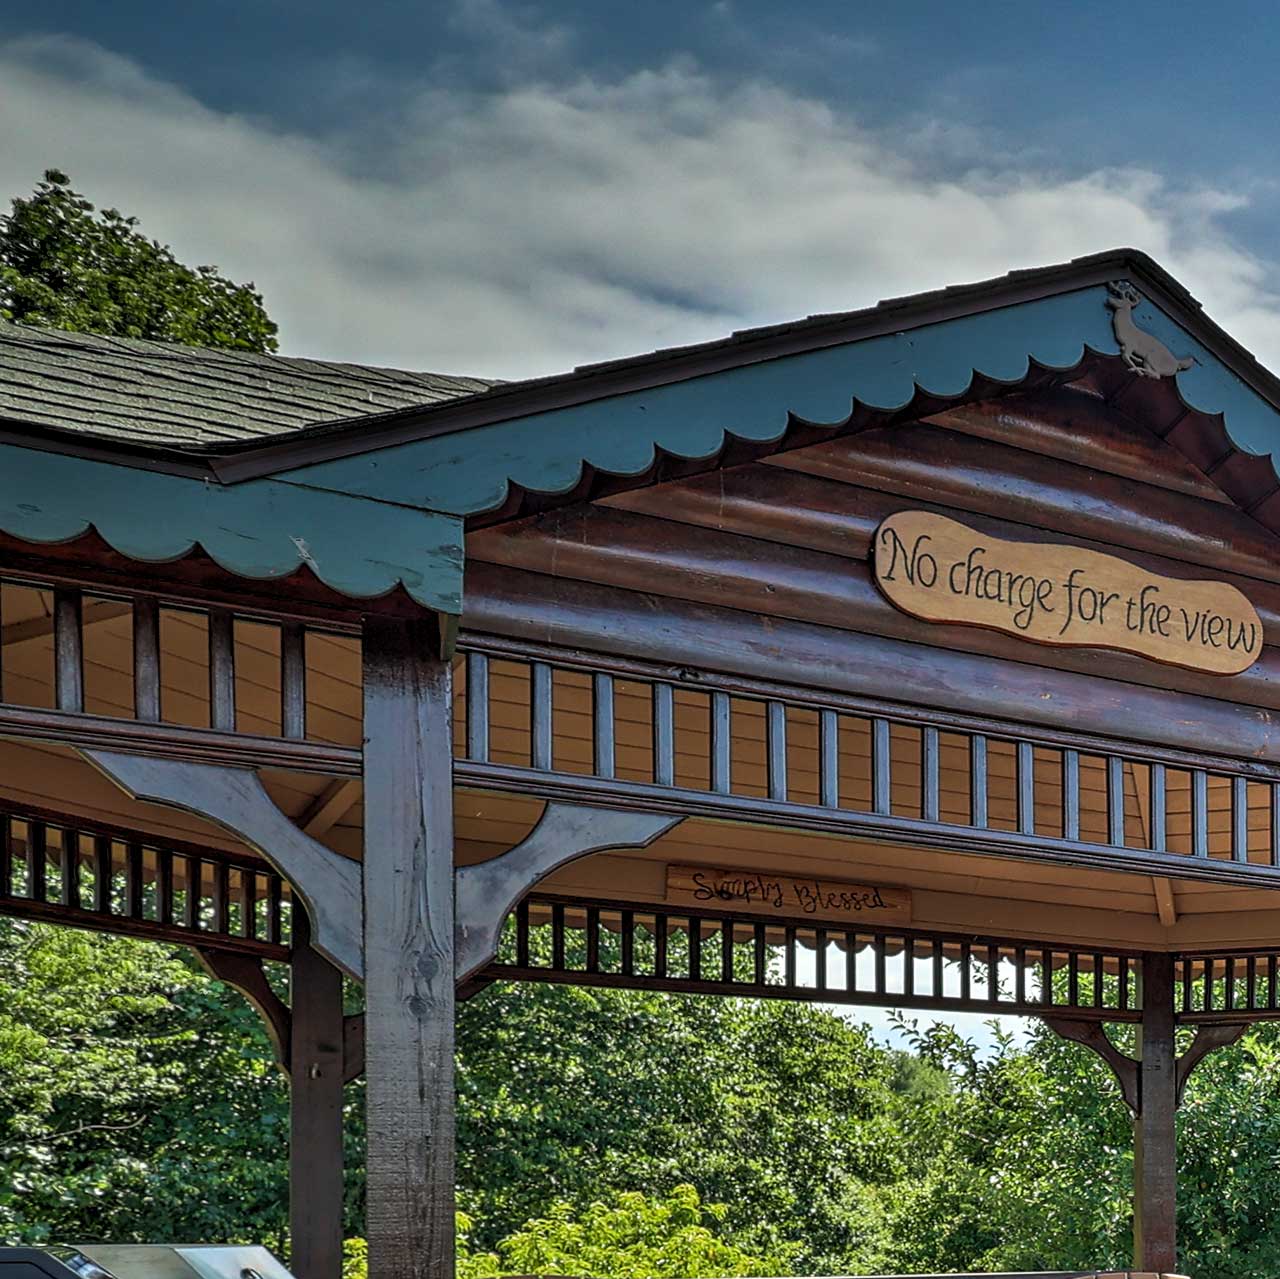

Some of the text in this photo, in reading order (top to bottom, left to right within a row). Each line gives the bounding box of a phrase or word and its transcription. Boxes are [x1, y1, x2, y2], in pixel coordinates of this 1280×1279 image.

[881, 527, 1256, 655] No charge for the view
[793, 880, 888, 914] Blessed
